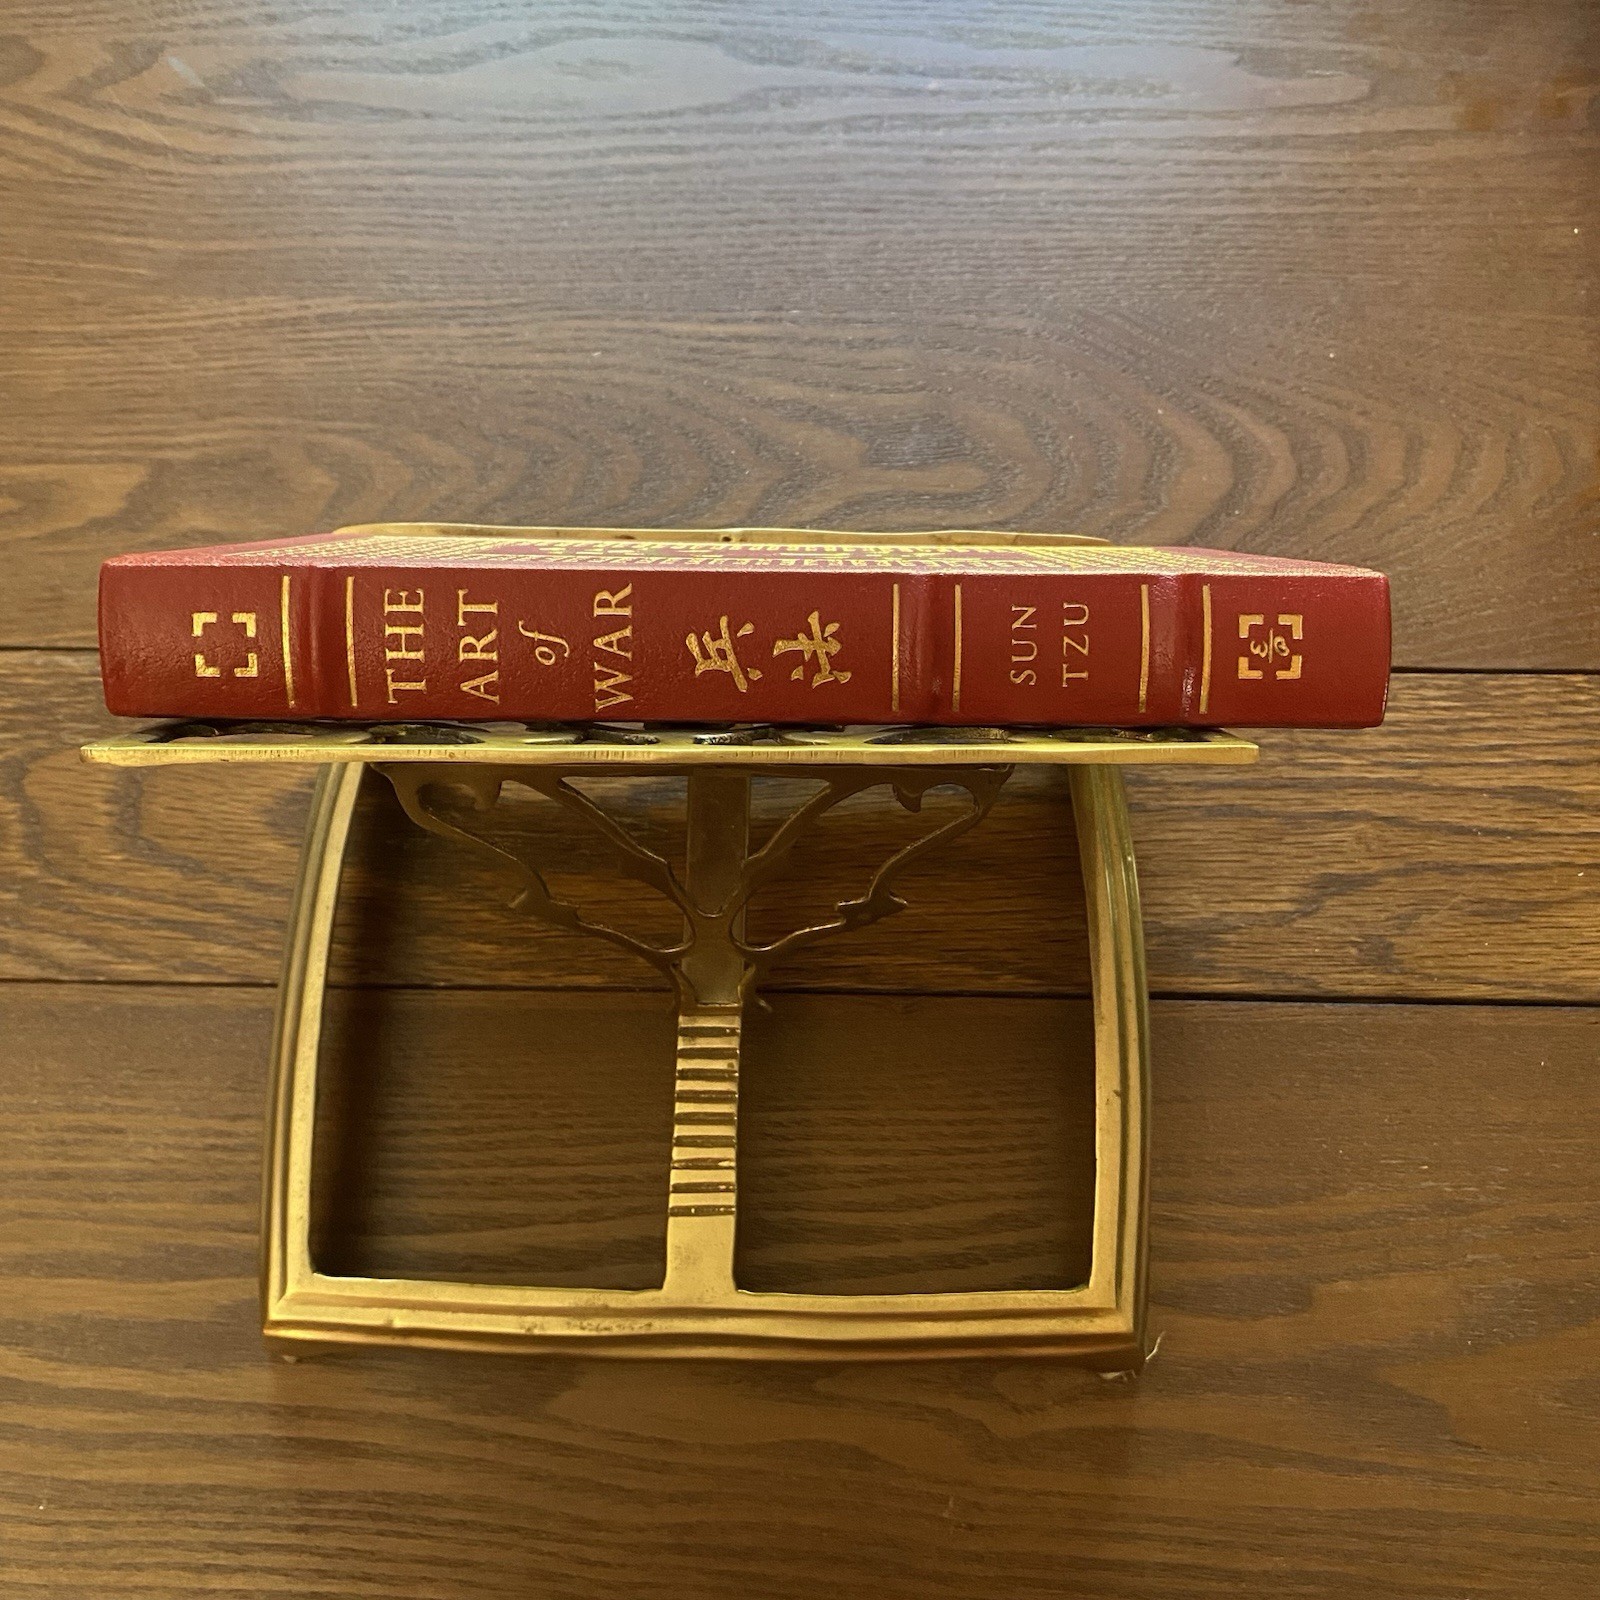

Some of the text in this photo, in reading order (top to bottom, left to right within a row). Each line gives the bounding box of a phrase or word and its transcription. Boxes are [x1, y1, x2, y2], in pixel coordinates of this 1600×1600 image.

[384, 587, 427, 705] THE
[458, 588, 501, 704] ART
[518, 619, 571, 667] of
[594, 582, 635, 713] WAR
[1010, 605, 1039, 687] SUN
[1062, 601, 1091, 689] TZU
